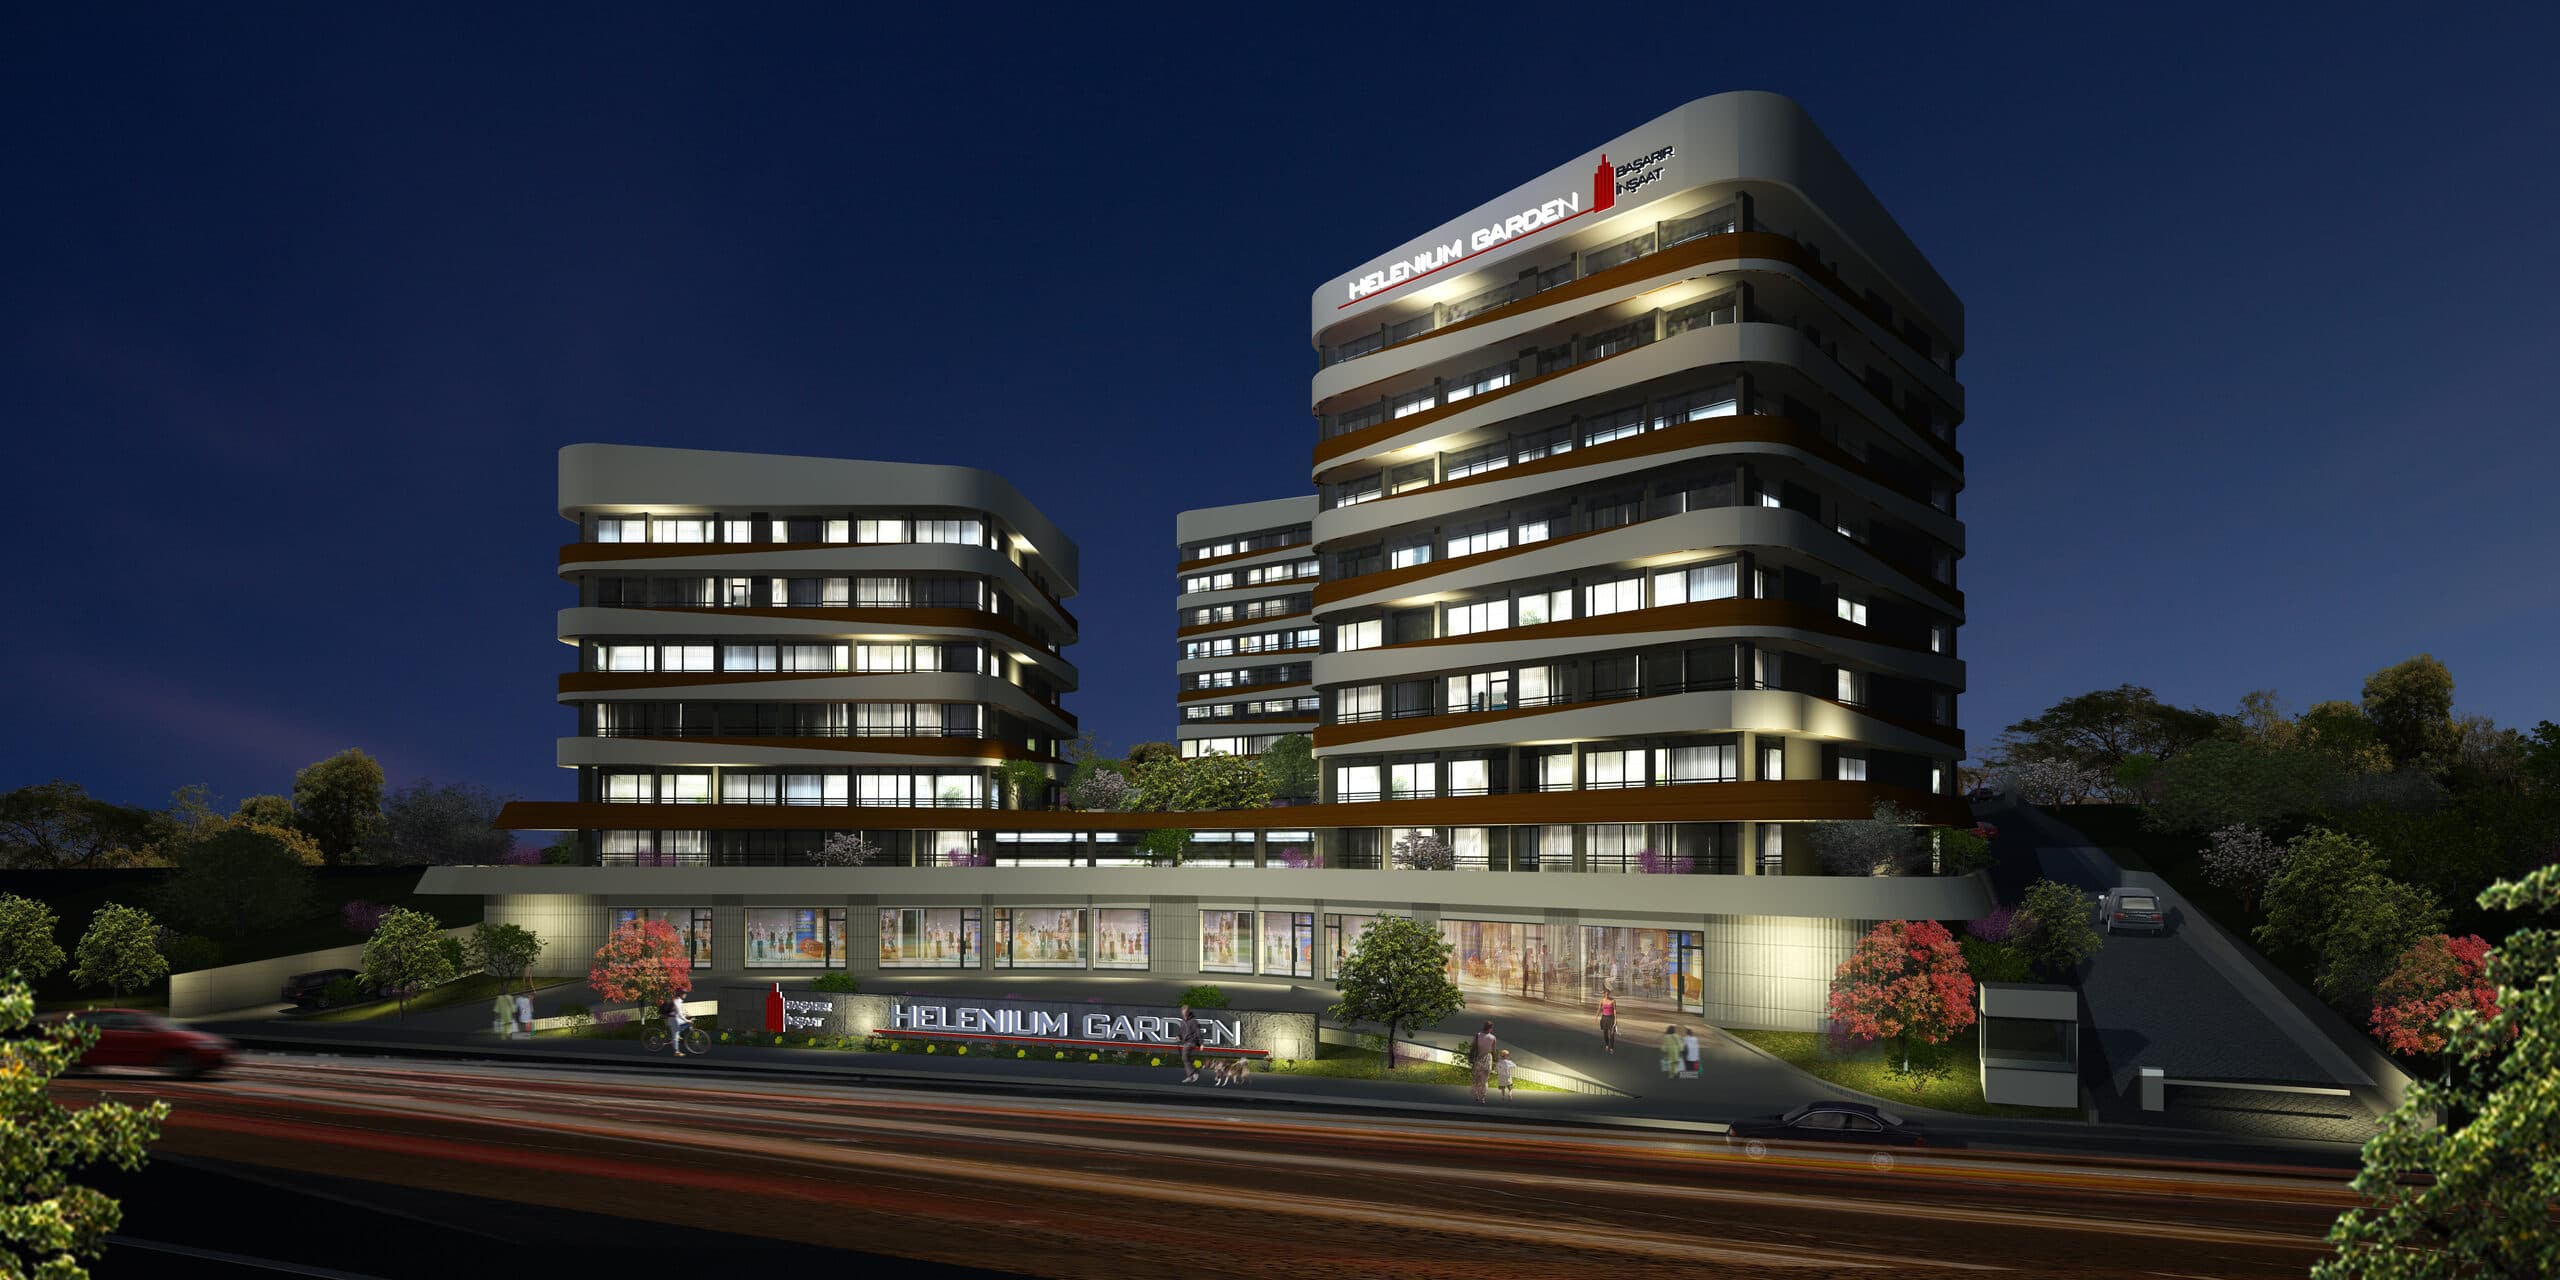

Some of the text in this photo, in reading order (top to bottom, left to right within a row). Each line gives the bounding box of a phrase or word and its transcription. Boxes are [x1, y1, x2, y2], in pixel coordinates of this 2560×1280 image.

[1616, 145, 1675, 179] BAŞARIR
[1616, 167, 1665, 196] İNŞAAT
[1349, 191, 1579, 300] HELENIUM GARDEN
[891, 1004, 1241, 1046] HELENIUM GARDEN
